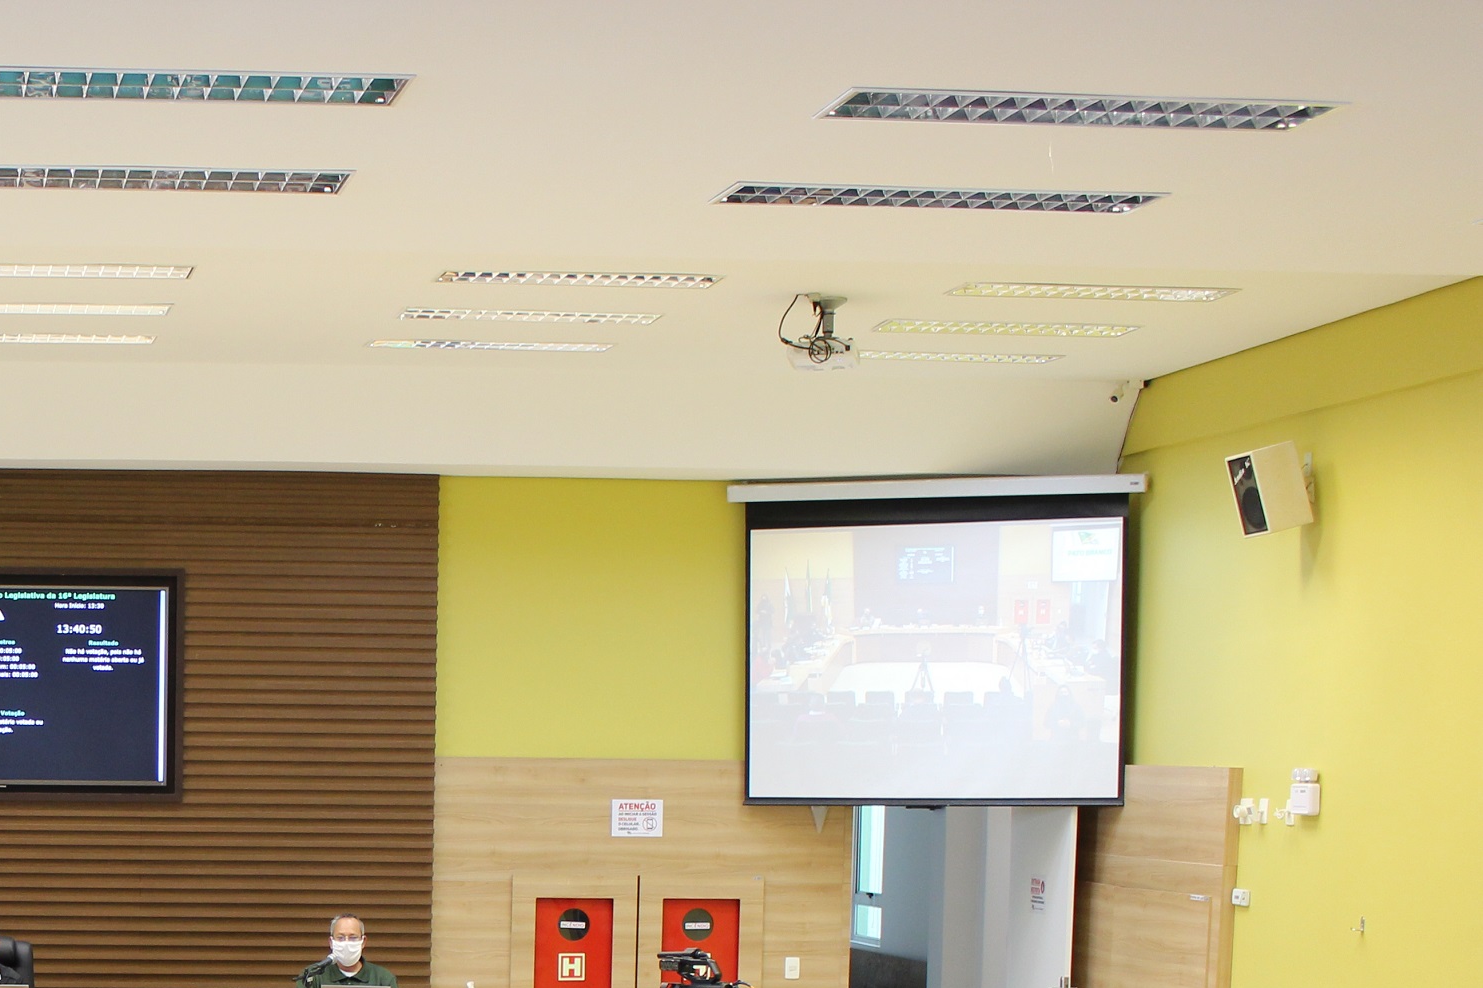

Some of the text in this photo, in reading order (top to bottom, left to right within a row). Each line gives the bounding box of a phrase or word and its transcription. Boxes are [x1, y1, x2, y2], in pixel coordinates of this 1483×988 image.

[5, 592, 45, 600] Legislativa
[57, 624, 102, 634] 13:40:50
[619, 801, 656, 812] ATENÇÃO
[562, 957, 580, 976] H
